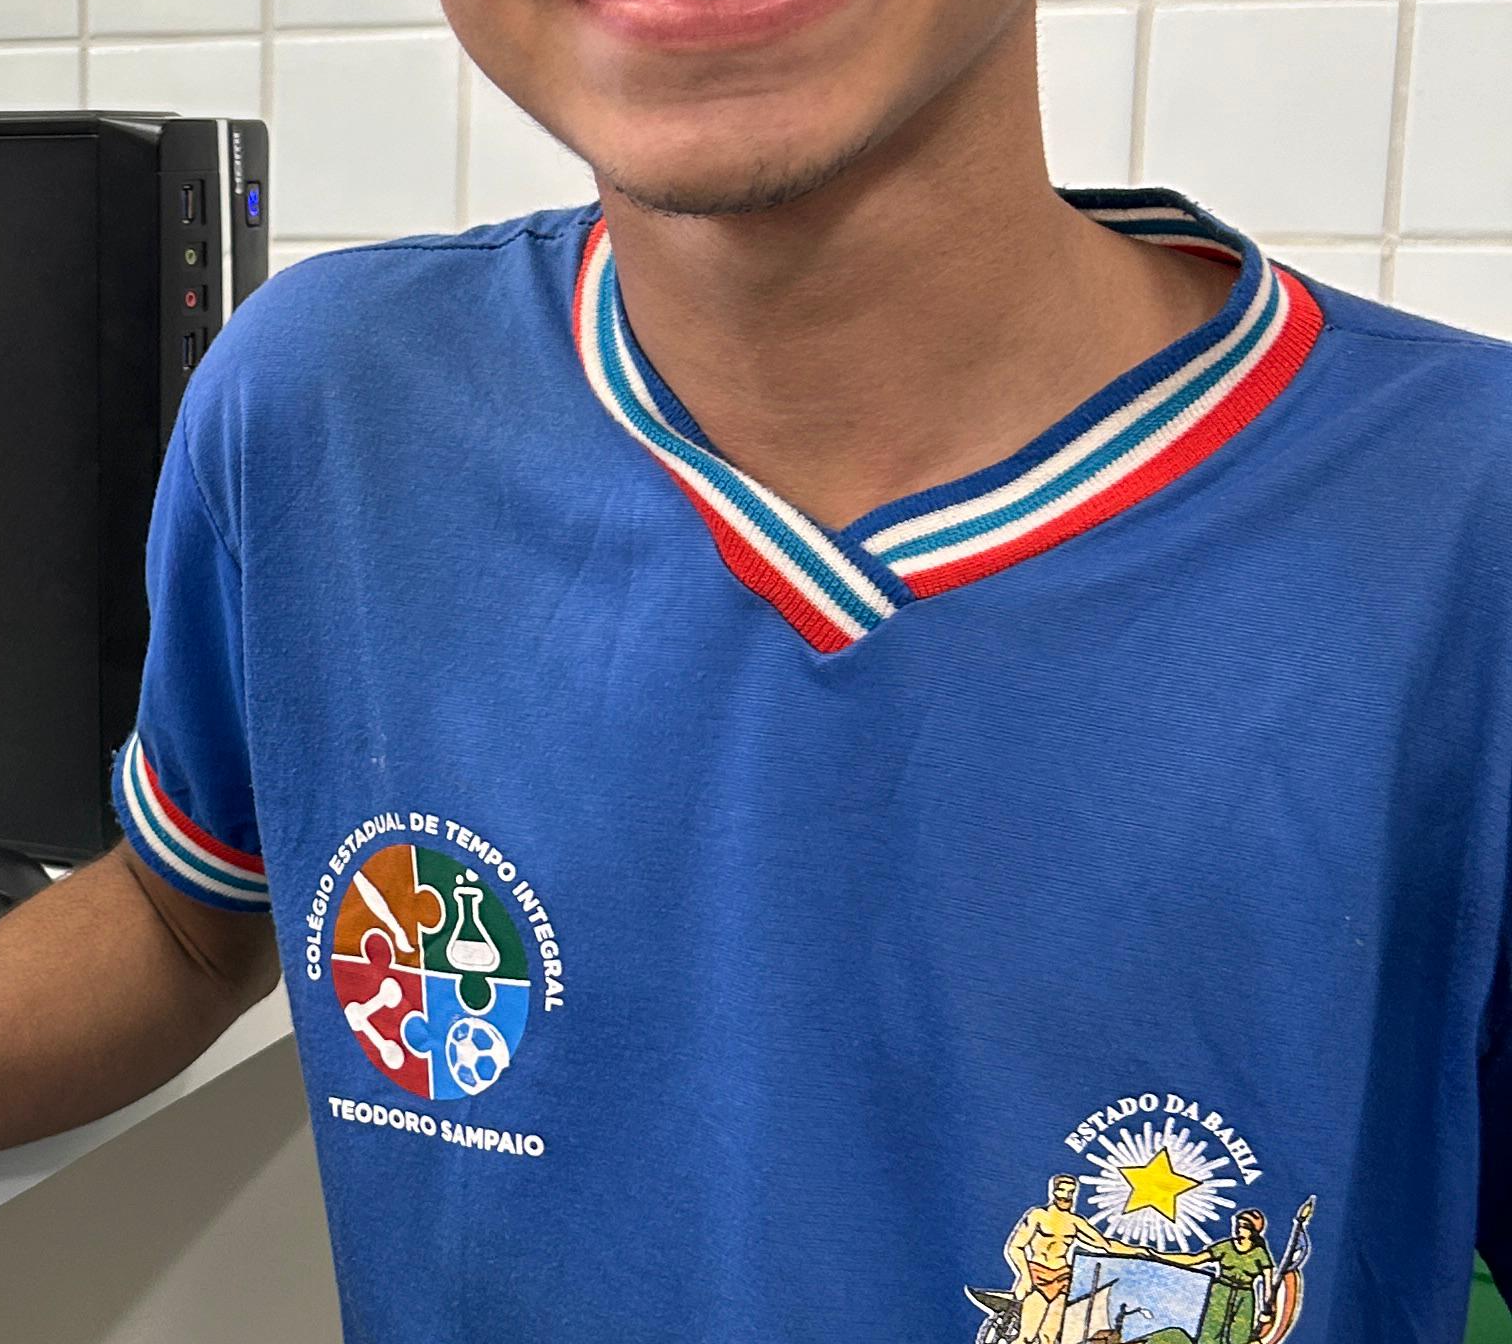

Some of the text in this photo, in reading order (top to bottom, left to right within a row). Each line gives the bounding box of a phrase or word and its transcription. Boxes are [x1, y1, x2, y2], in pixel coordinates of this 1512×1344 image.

[306, 812, 565, 1012] COLÉGIO ESTADUAL DE TEMPO INTEGRAL
[328, 1097, 545, 1157] TEODORO SAMPAIO
[1064, 1093, 1264, 1185] ESTADO DA BAHIA
